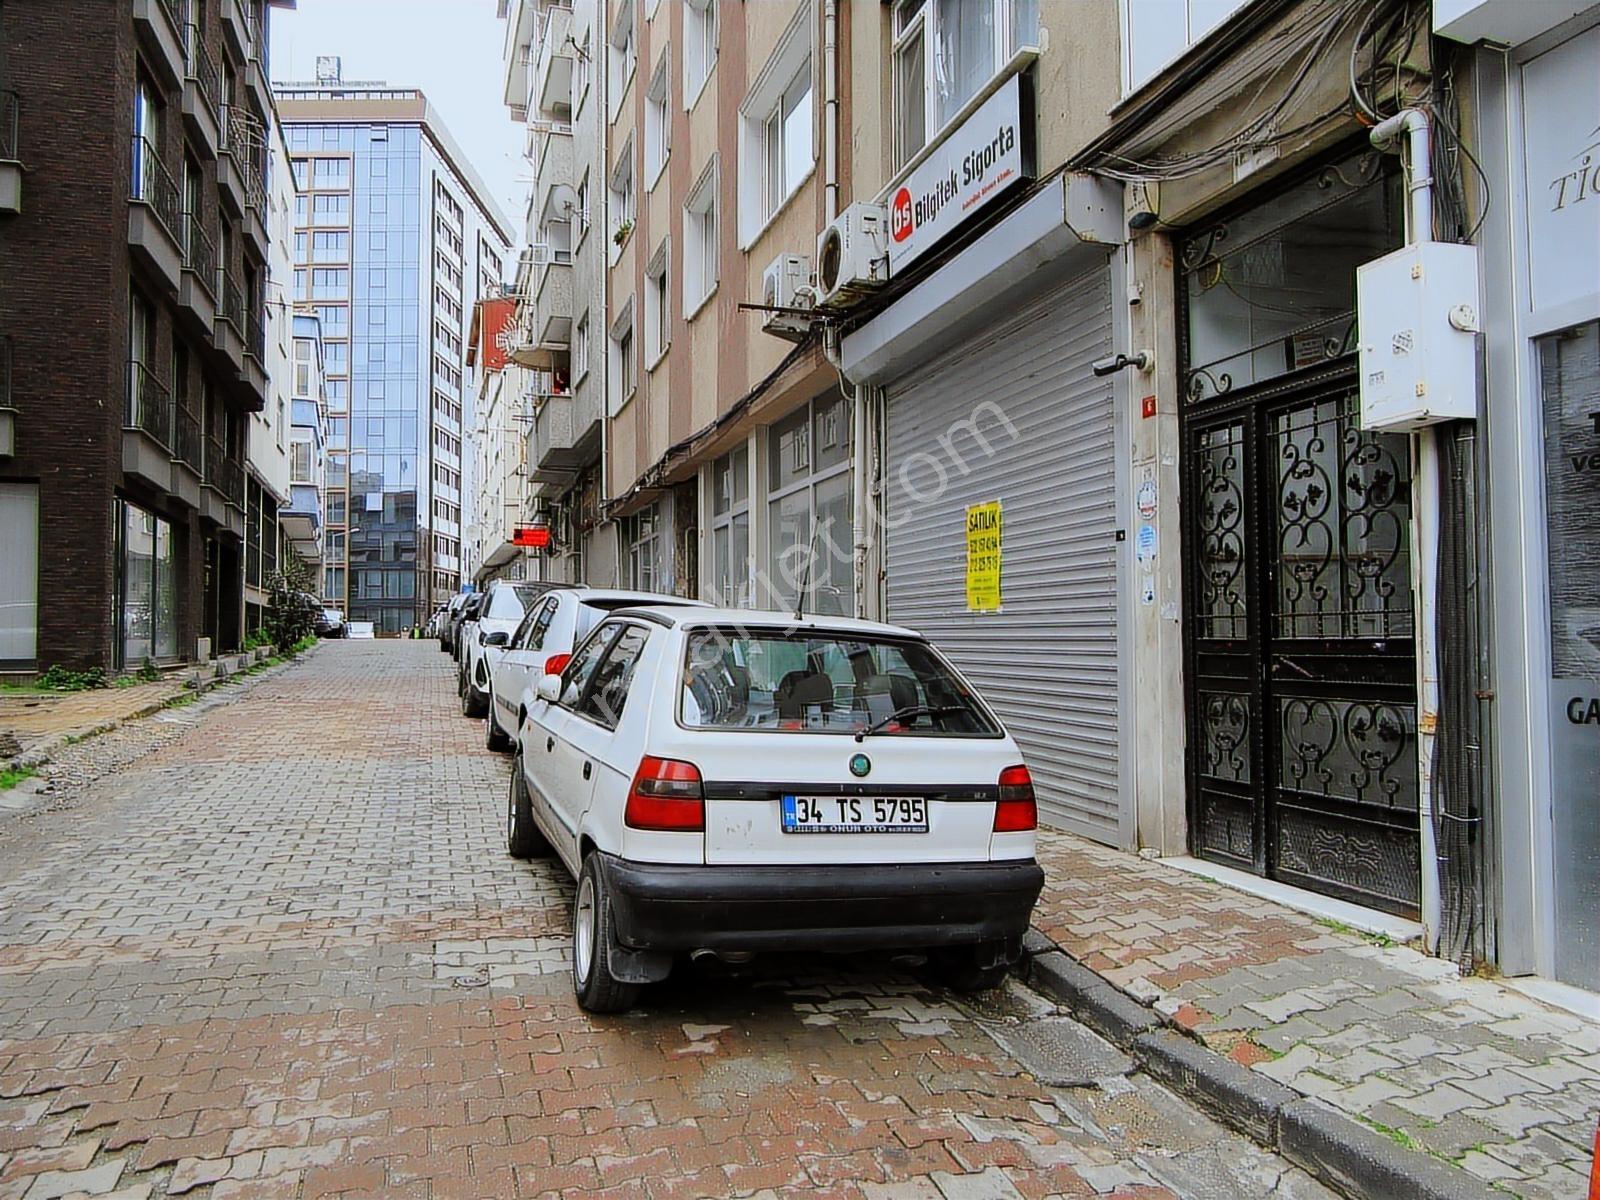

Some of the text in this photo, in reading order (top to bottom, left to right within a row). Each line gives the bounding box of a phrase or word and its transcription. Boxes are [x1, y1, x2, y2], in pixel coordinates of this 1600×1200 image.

[915, 169, 958, 229] Bilgitek
[963, 125, 1015, 186] Sigorta
[797, 799, 924, 823] 34 TS 5795
